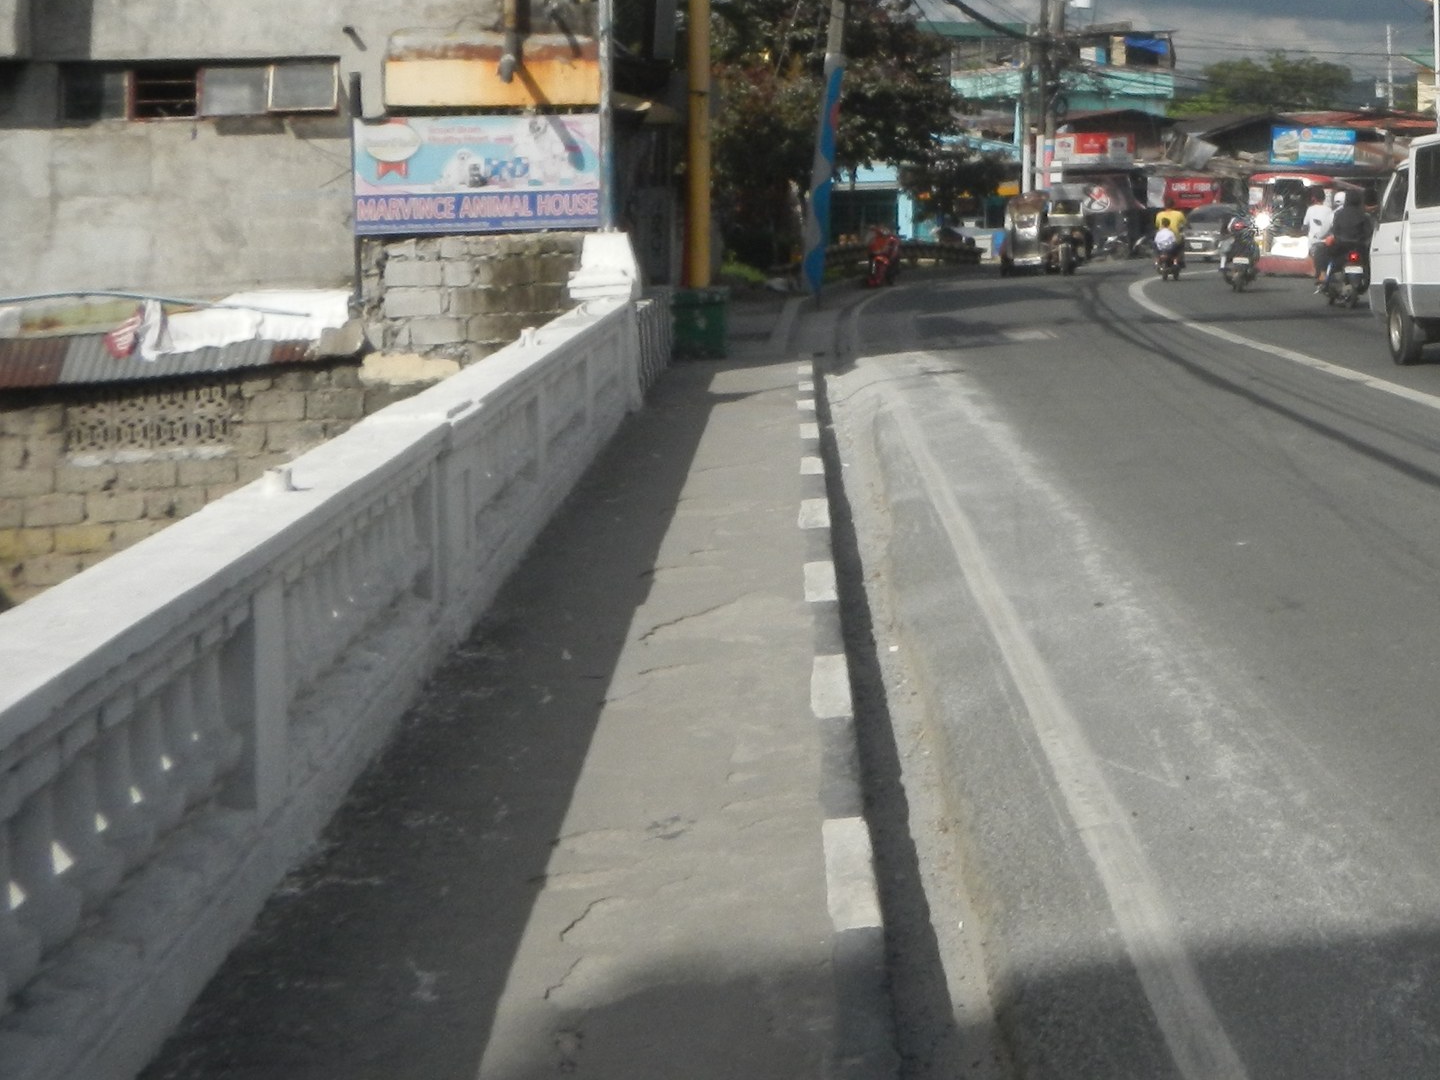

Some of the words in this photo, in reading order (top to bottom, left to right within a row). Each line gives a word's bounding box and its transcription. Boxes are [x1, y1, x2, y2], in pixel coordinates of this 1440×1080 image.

[357, 197, 455, 221] MARVINCE
[459, 195, 533, 219] ANIMAL
[536, 193, 599, 216] HOUSE
